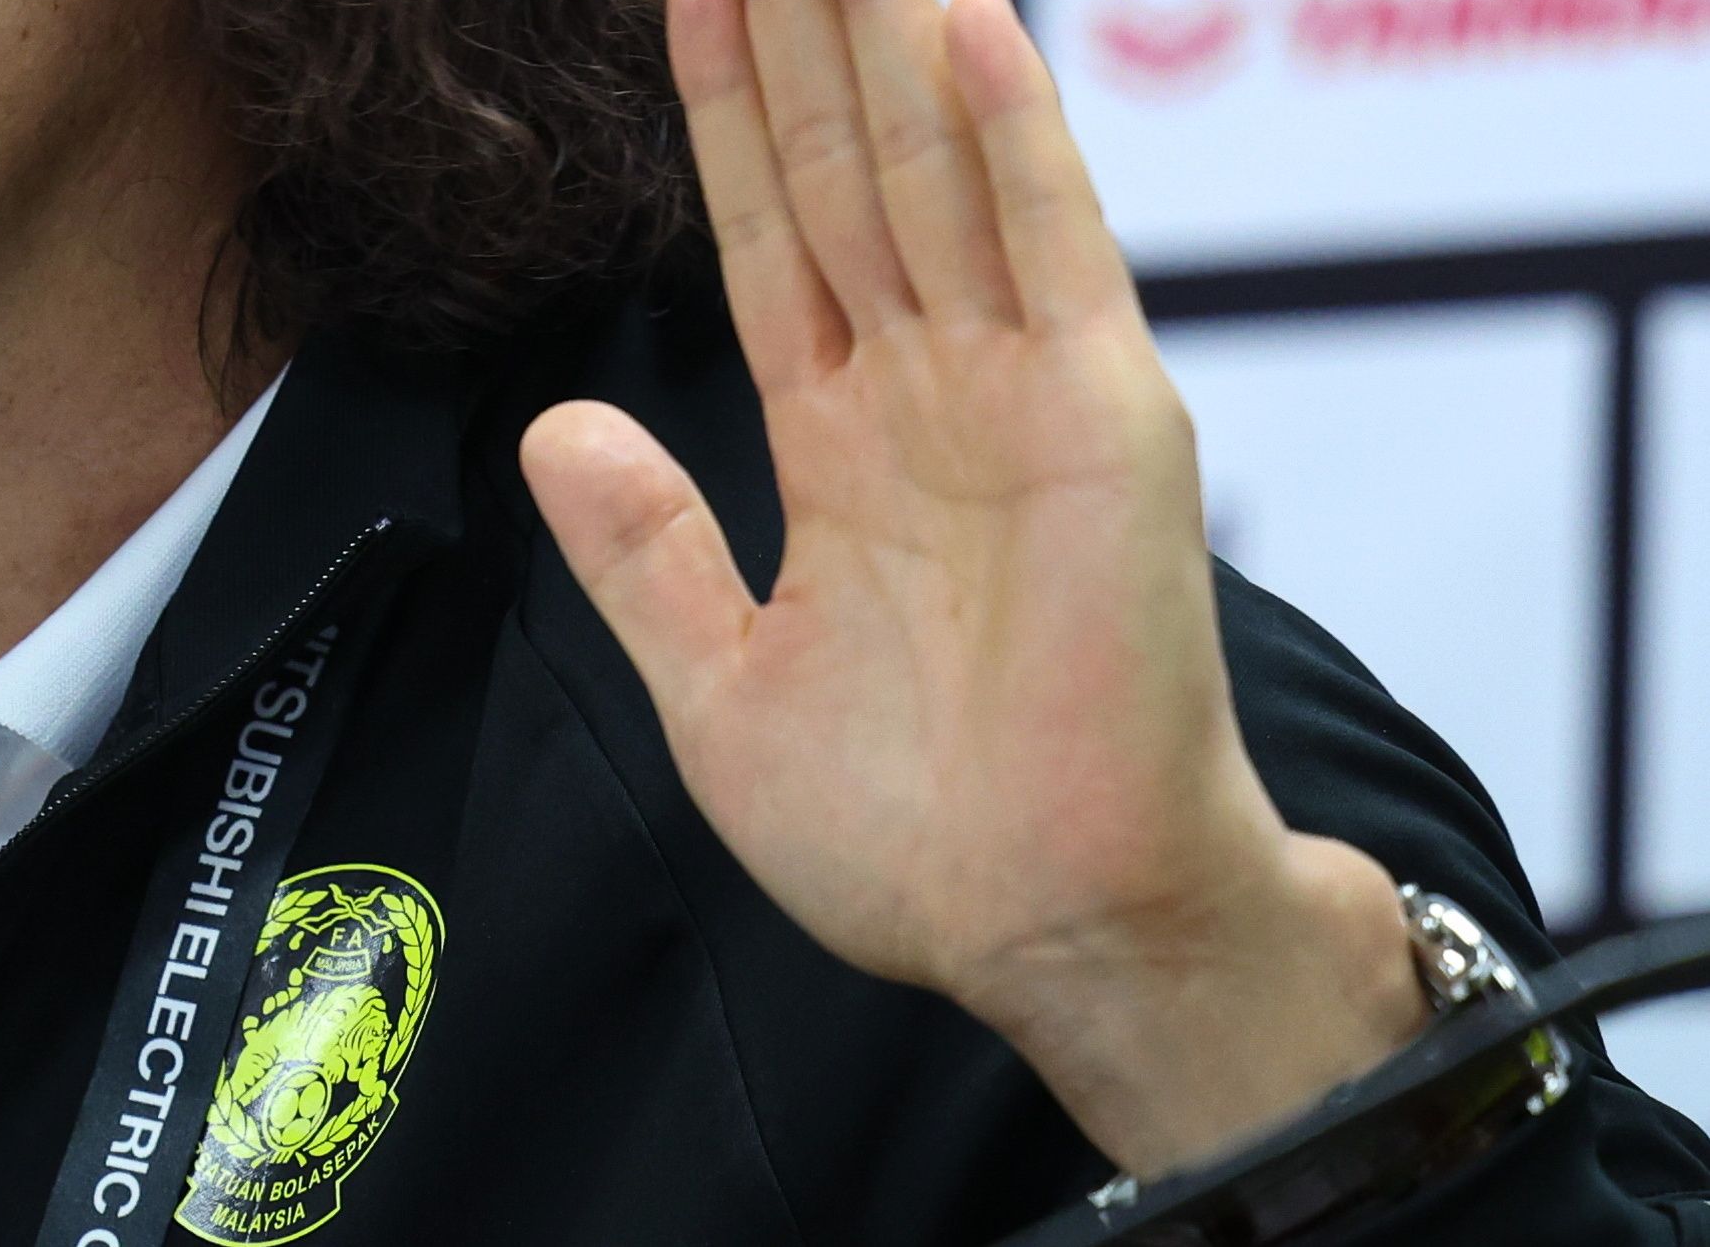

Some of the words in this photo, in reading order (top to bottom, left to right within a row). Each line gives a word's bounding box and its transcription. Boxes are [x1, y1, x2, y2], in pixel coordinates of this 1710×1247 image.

[93, 922, 217, 1219] ELECTRIC
[269, 1115, 381, 1201] BOLASEPAK
[210, 1201, 306, 1234] MALAYSIA
